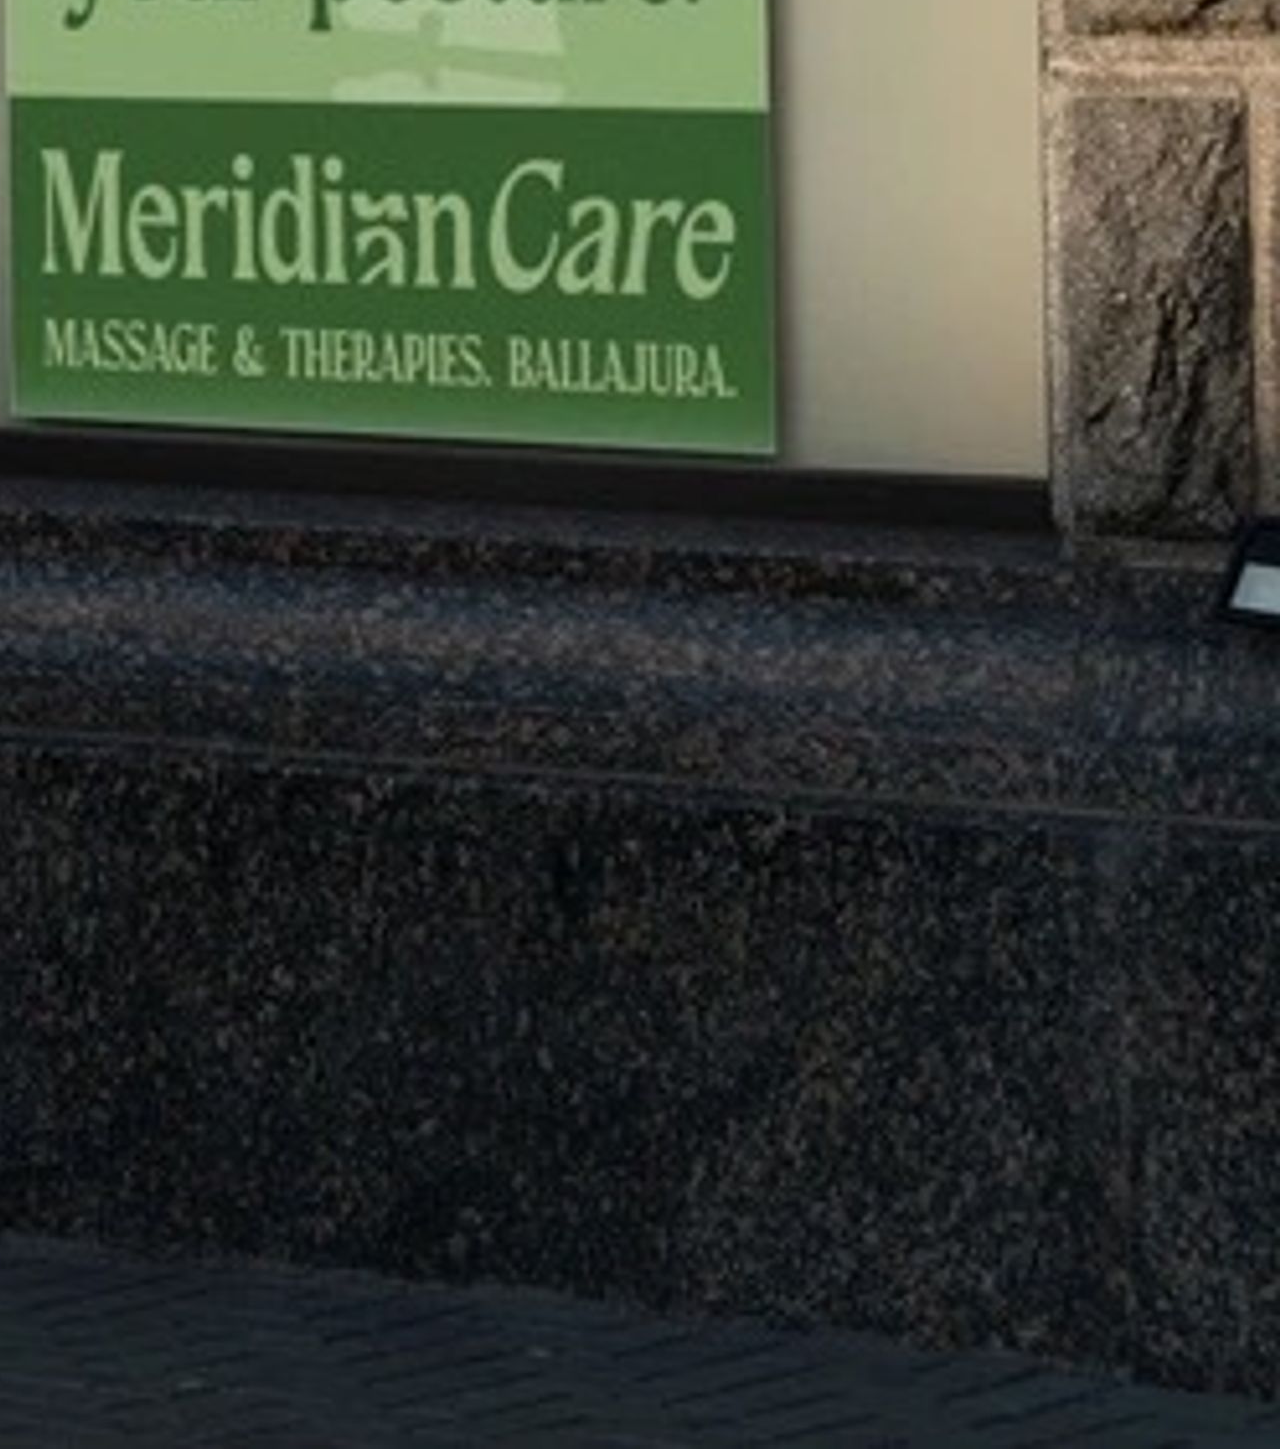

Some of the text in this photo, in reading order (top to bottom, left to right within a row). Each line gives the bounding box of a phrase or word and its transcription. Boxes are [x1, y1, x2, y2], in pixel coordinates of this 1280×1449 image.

[44, 317, 738, 399] MASSAGE & THERAPIES. BALLAJURA.
